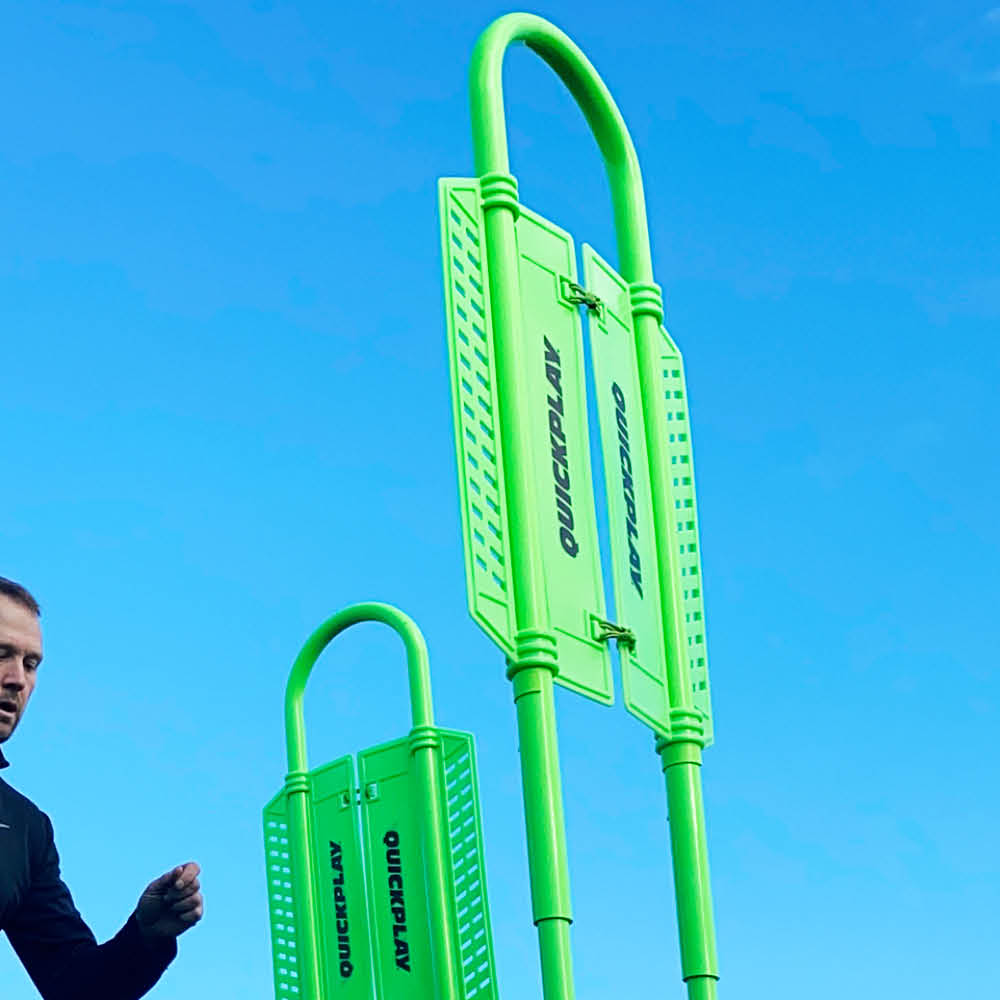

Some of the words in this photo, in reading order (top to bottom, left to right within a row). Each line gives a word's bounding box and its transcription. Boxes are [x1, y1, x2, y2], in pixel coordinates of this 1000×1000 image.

[543, 335, 579, 558] QUICKPLAY
[612, 382, 644, 600] QUICKPLAY
[329, 840, 353, 978] QUICKPLAY
[383, 830, 411, 973] QUICKPLAY
